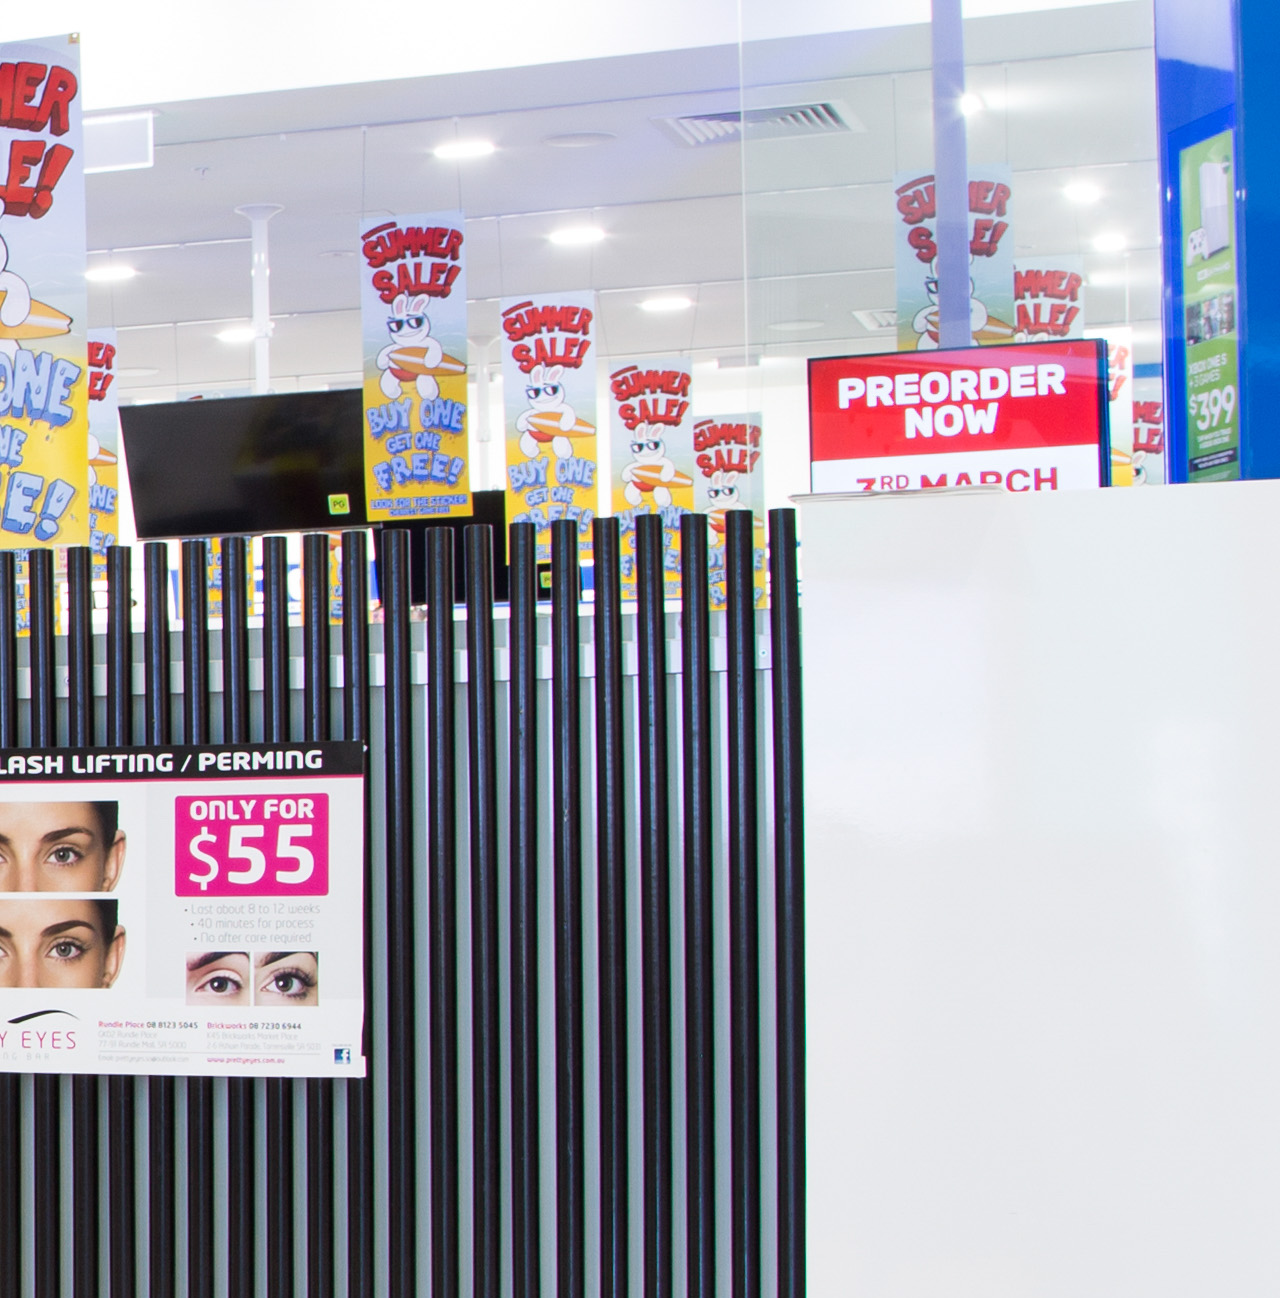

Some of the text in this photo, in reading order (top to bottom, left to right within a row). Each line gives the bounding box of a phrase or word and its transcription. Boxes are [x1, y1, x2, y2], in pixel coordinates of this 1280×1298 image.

[897, 180, 1010, 225] SUER
[362, 226, 464, 270] SUMMER
[372, 262, 461, 305] SALE!
[503, 305, 593, 342] SUMMER
[1016, 303, 1080, 337] ALE!
[512, 337, 591, 374] SALE!
[611, 370, 691, 401] SUMMER
[838, 364, 1066, 409] PREORDER
[366, 398, 465, 438] BUY ONE
[619, 398, 689, 431] SALE!
[904, 402, 998, 439] NOW
[1189, 385, 1235, 430] $399
[385, 431, 441, 454] GET ONE
[694, 423, 762, 451] SUMMER
[372, 453, 464, 491] FREE!
[507, 457, 597, 492] BUY ONE
[332, 500, 346, 510] PG
[525, 486, 574, 507] GET ONE
[71, 752, 173, 775] LIFTING
[180, 752, 192, 774] /
[198, 749, 324, 772] PERMING
[189, 798, 315, 821] ONLY FOR
[188, 823, 315, 891] $55
[191, 903, 321, 915] Last about 8 to 12 weeks
[197, 918, 314, 930] 40 minutes for process
[200, 932, 312, 944] No after care required
[22, 1030, 76, 1049] EYES
[98, 1021, 123, 1029] Rundle
[125, 1021, 144, 1029] Place
[26, 1052, 51, 1060] BAR
